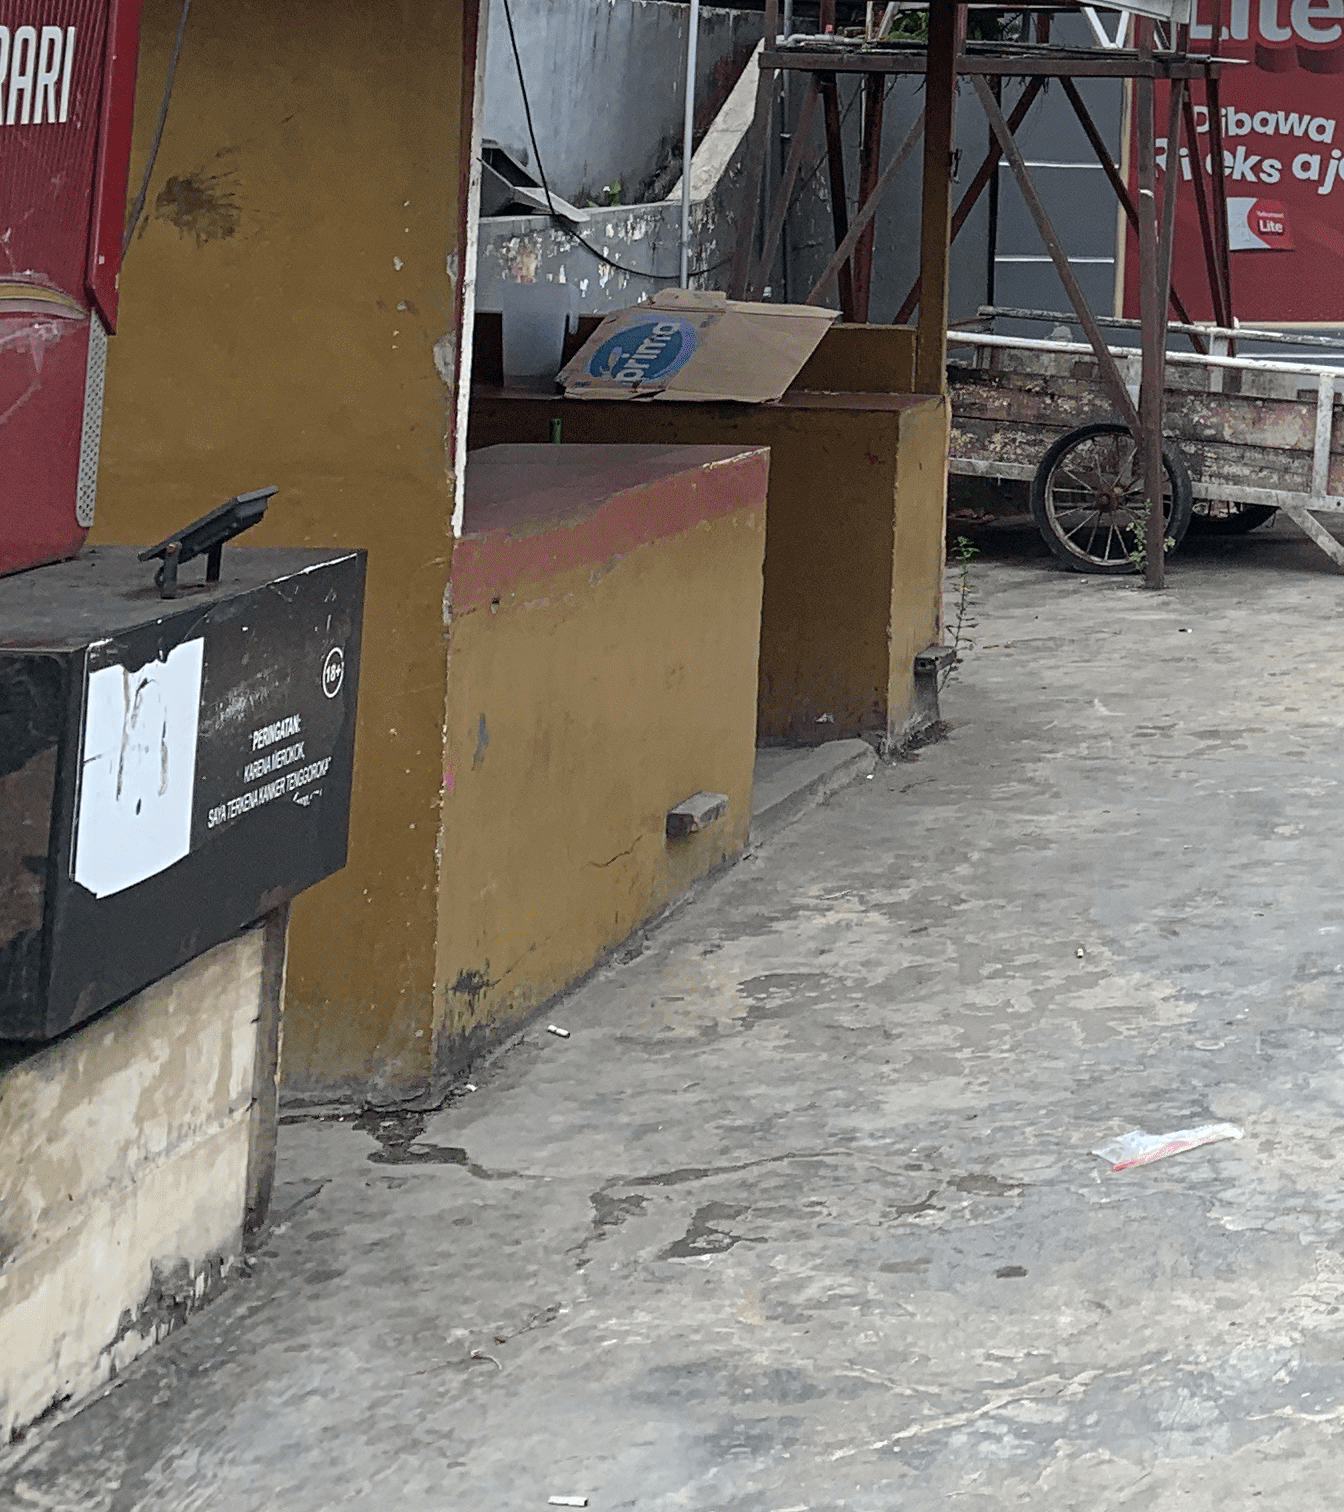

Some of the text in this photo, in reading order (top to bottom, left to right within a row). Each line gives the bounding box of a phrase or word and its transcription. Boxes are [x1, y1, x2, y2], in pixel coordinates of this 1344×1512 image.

[1155, 137, 1282, 185] ieks
[1259, 219, 1283, 233] Lite
[325, 663, 342, 683] 18+
